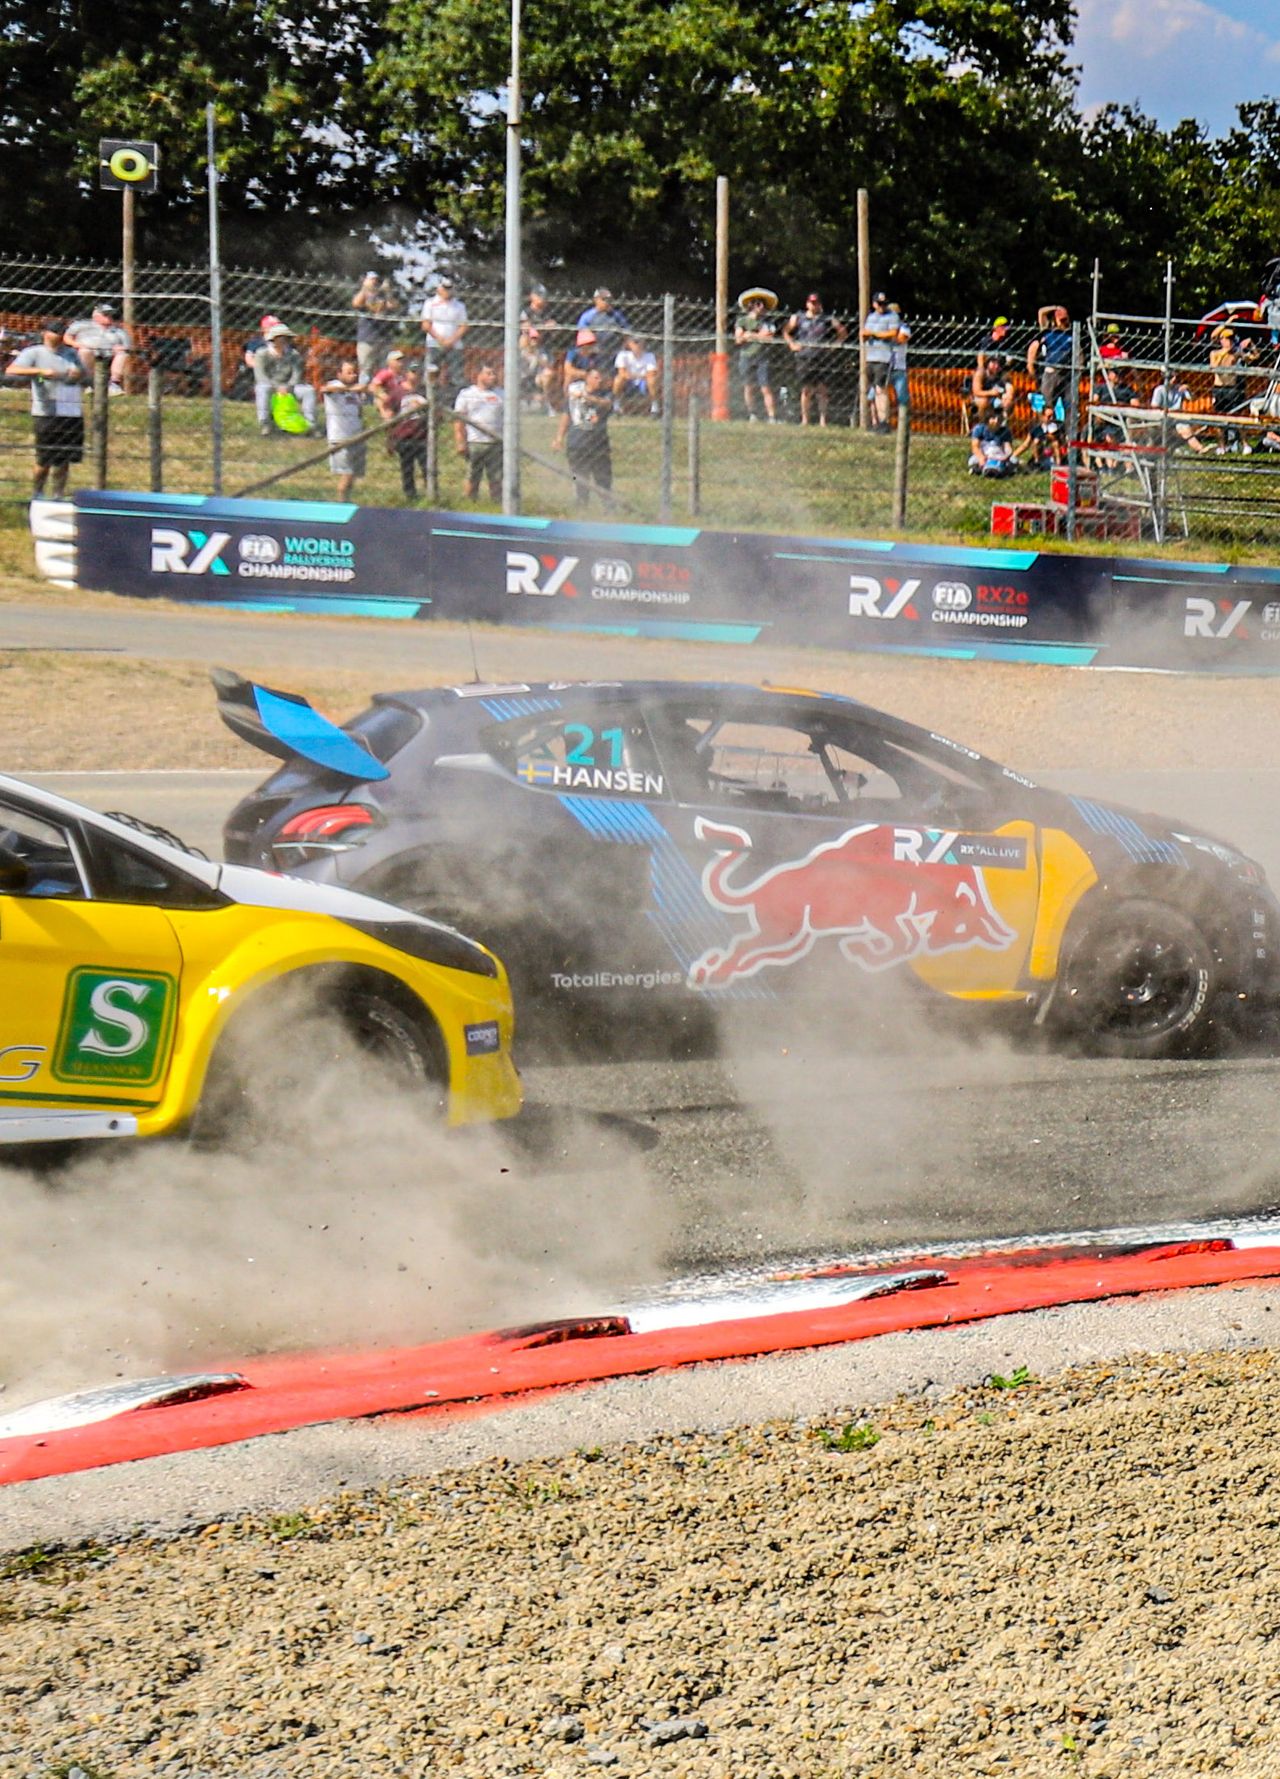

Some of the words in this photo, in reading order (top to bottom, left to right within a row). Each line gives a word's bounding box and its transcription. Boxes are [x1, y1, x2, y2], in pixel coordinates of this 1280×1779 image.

[151, 528, 232, 576] RX
[240, 538, 277, 560] FIA
[284, 536, 355, 556] WORLD
[238, 562, 355, 582] CHAMPIONSHIP
[506, 551, 579, 597] RX
[593, 561, 630, 584] FIA
[591, 587, 690, 604] CHAMPIONSHIP
[849, 575, 921, 621] RX
[934, 584, 969, 607] FIA
[976, 585, 1029, 606] RX2e
[932, 611, 1028, 628] CHAMPIONSHIP
[1184, 597, 1252, 640] RX
[564, 723, 624, 767] 21
[553, 766, 663, 794] HANSEN
[893, 828, 959, 865] RX
[999, 848, 1020, 858] LIVE
[551, 970, 682, 989] TotalEnergies
[78, 980, 151, 1057] S
